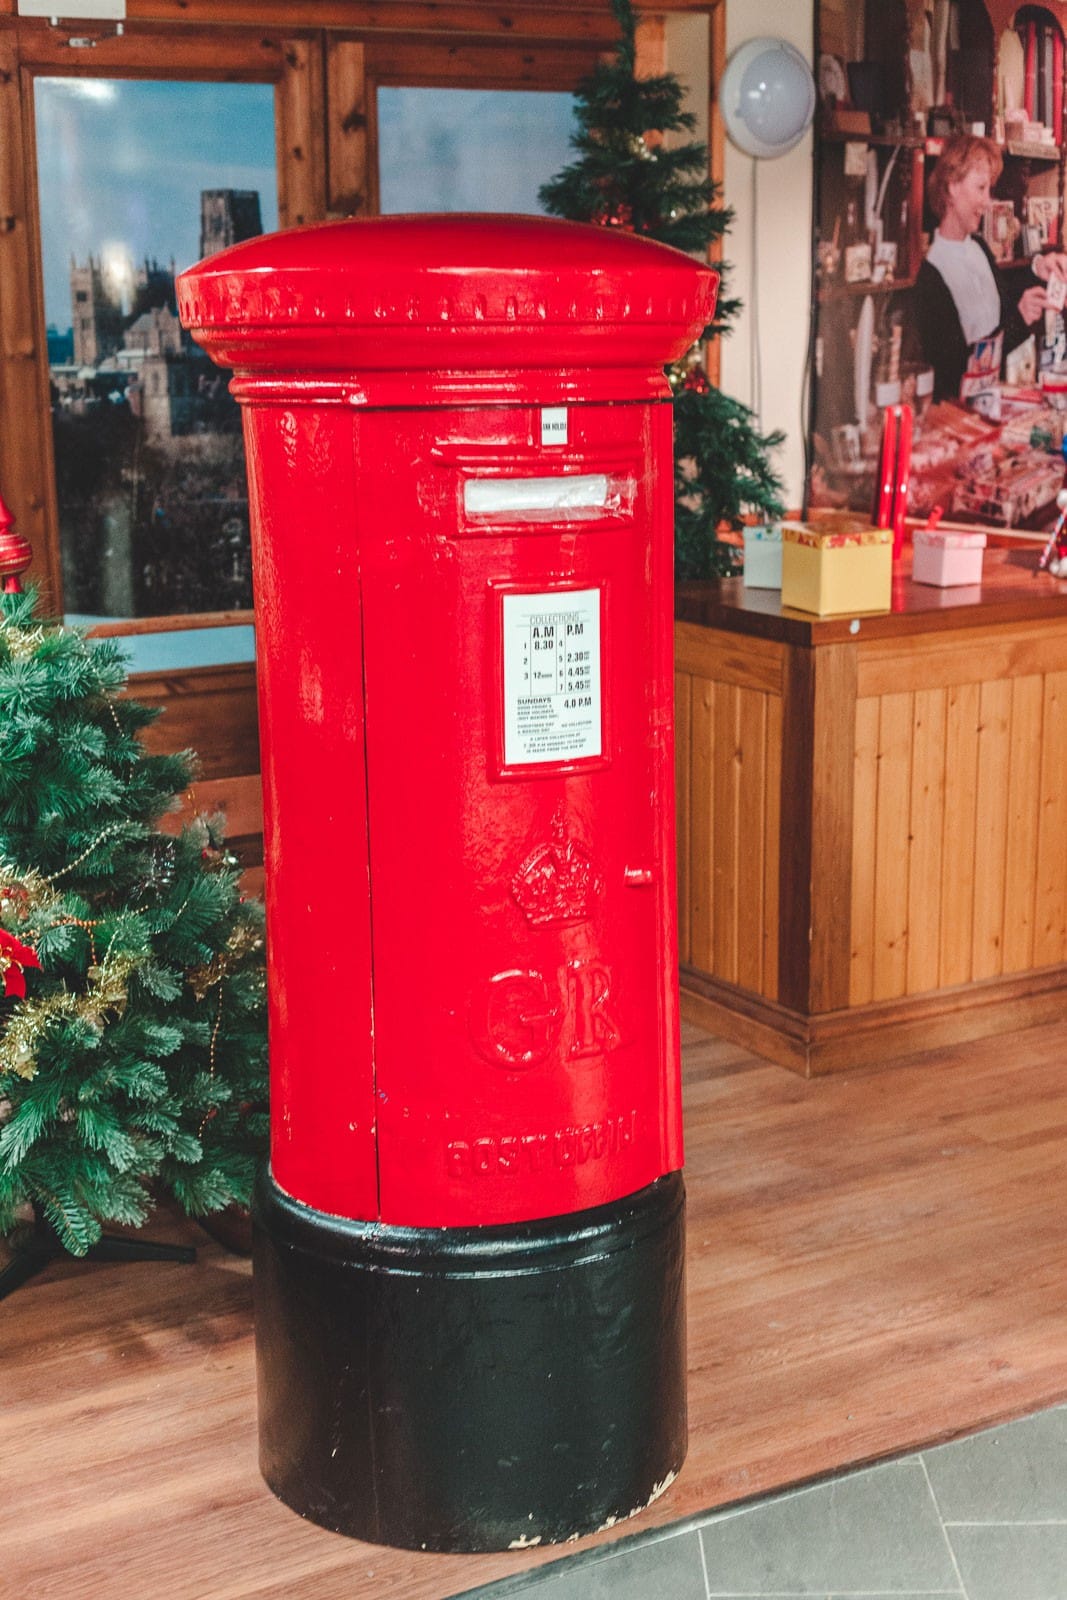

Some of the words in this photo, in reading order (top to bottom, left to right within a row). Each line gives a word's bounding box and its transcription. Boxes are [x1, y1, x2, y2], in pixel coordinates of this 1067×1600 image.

[530, 612, 580, 626] COLLECTIONS
[533, 626, 554, 638] A.M
[567, 623, 584, 636] P.M
[534, 640, 554, 651] 8.30
[567, 652, 584, 663] 2.30
[568, 667, 584, 677] 4.45
[568, 680, 584, 692] 5.45
[518, 697, 552, 705] SUNDAYS
